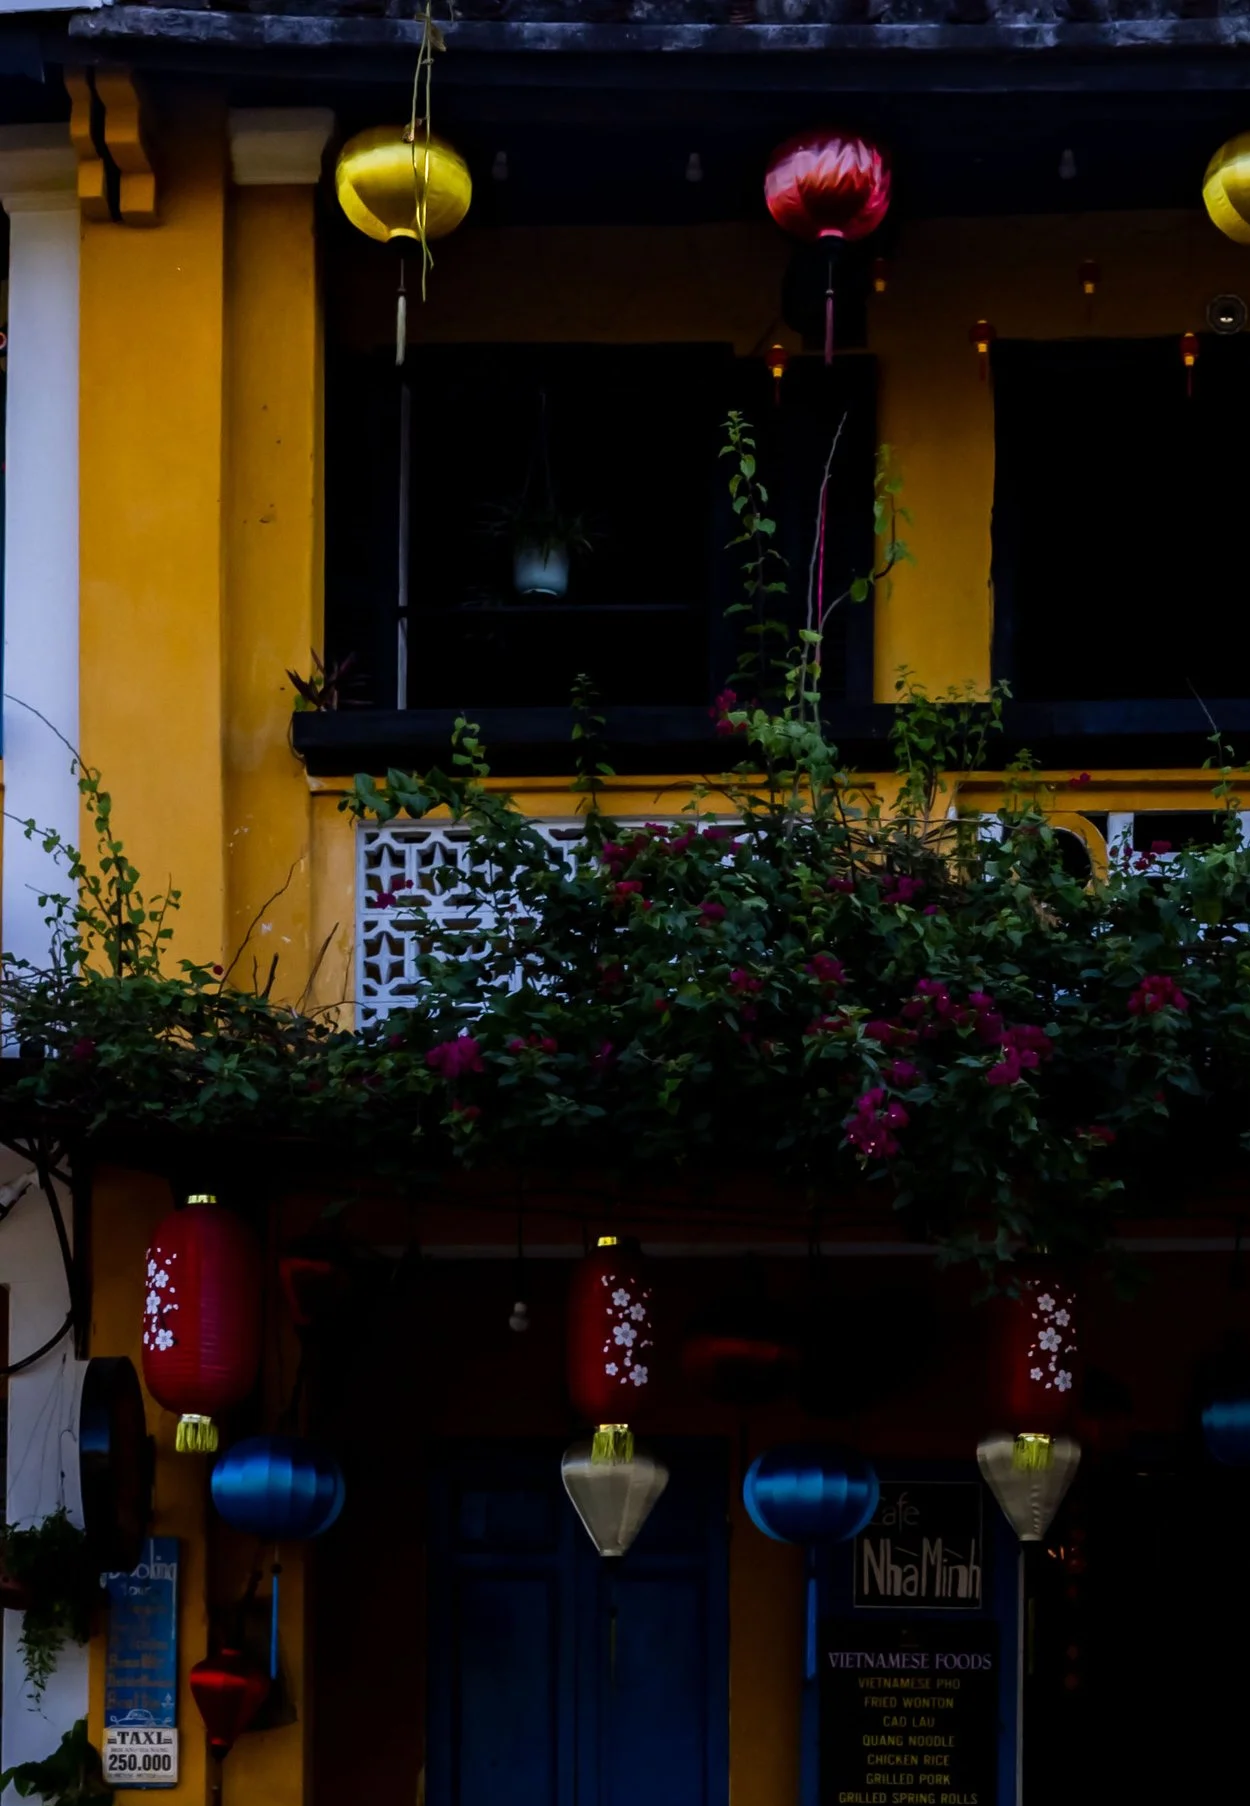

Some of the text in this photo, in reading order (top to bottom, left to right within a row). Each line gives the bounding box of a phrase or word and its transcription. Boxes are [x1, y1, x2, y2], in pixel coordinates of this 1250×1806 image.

[828, 1652, 992, 1669] VIETNAMESE FOODS
[858, 1677, 961, 1690] VIETNAMESE PHO
[864, 1696, 954, 1709] FRIED WONTON
[883, 1715, 936, 1728] CAO LAU
[117, 1731, 164, 1745] TAXI
[862, 1734, 956, 1748] QUANG NOODLE
[109, 1753, 172, 1772] 250.000
[867, 1754, 951, 1767] CHICKEN RICE
[866, 1773, 952, 1786] GRILLED PORK
[839, 1792, 979, 1805] GRILLED SPRING ROLLS
